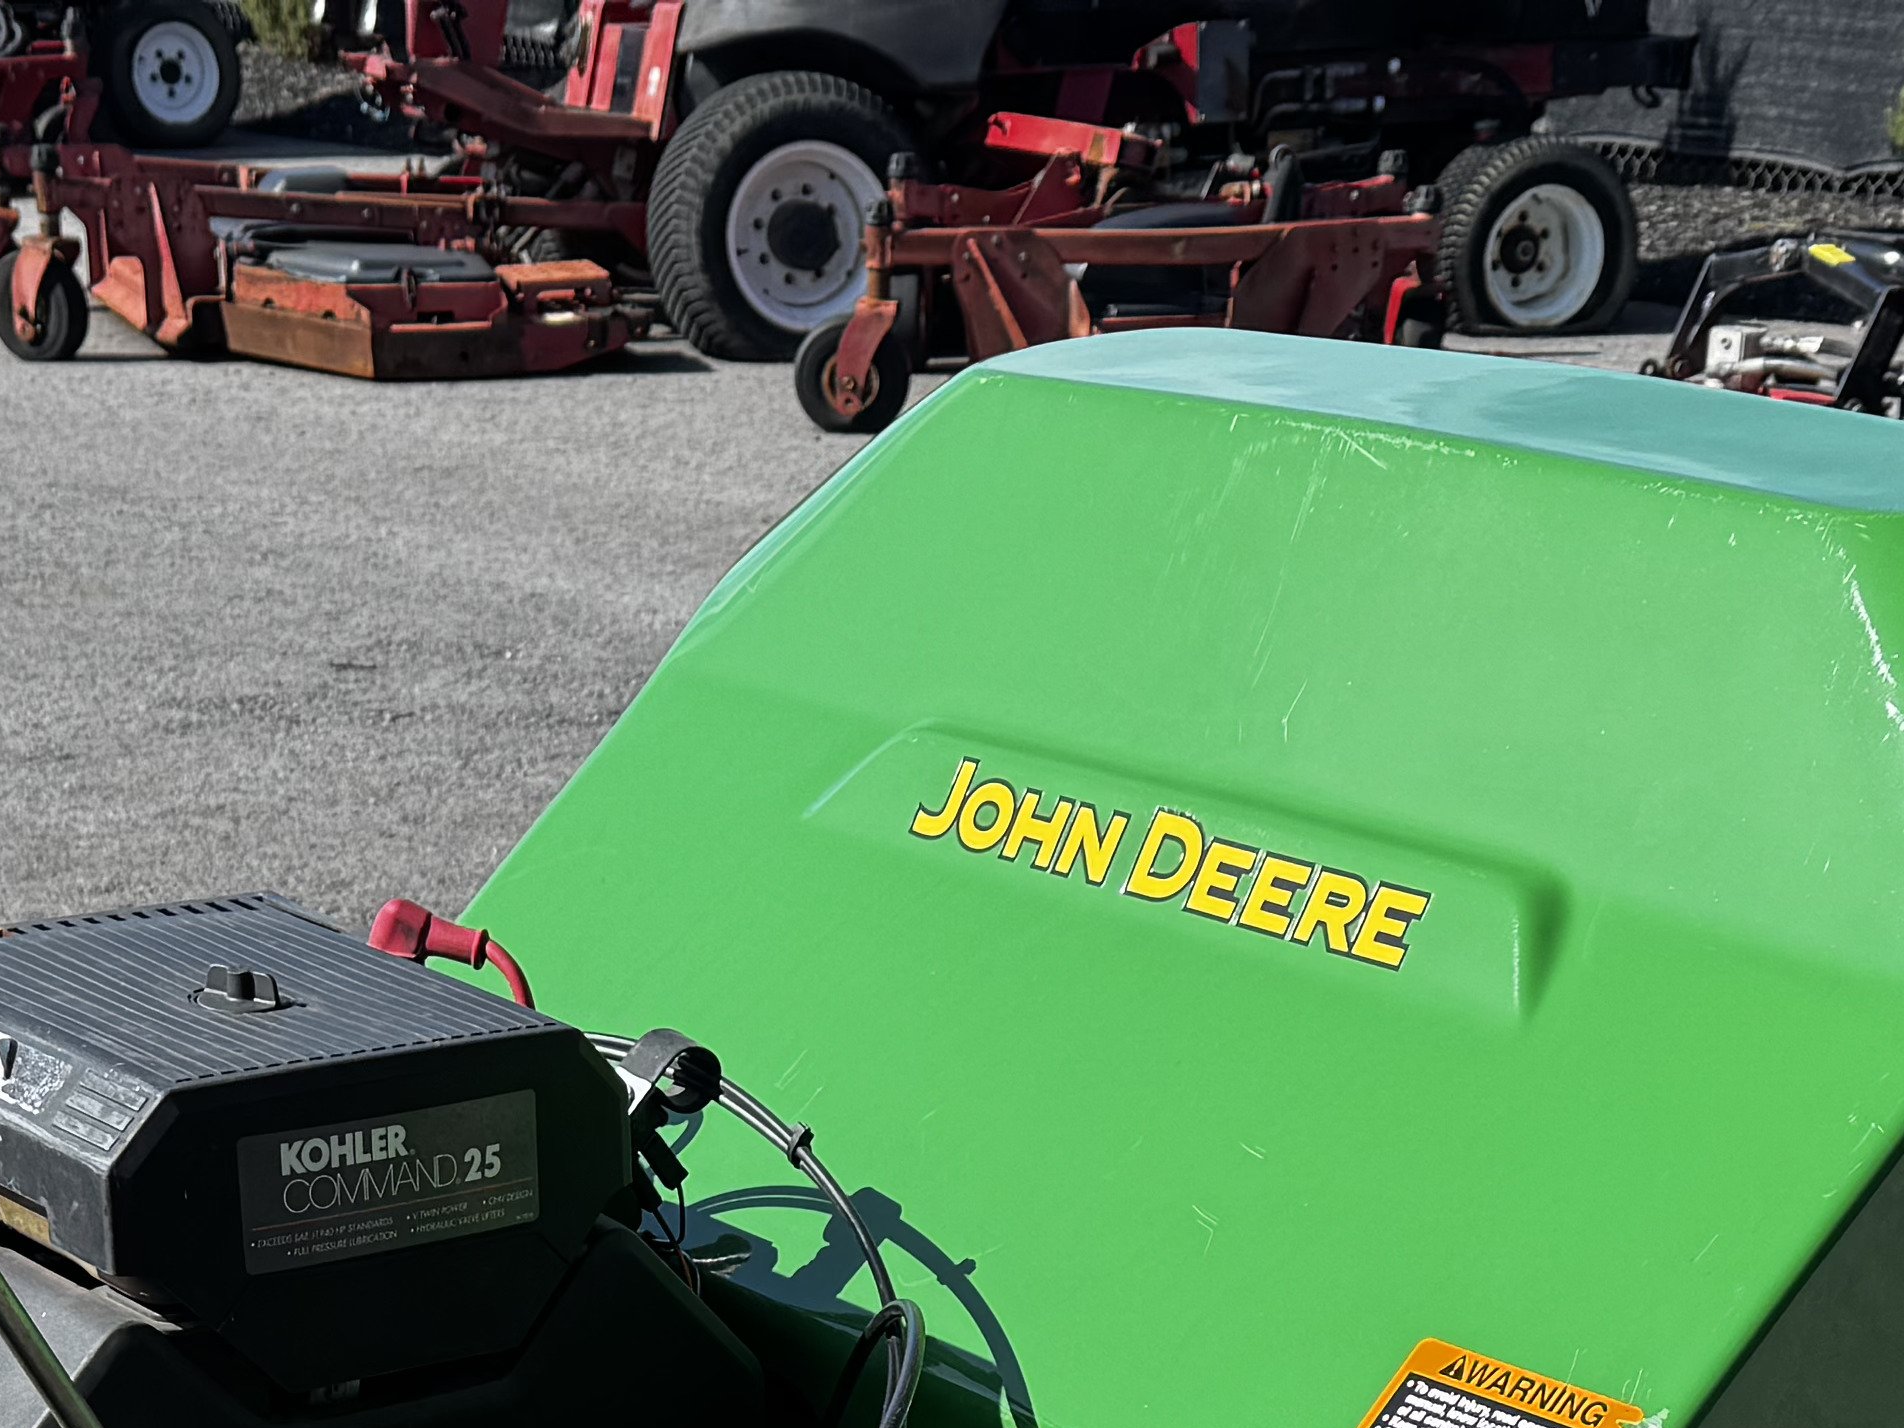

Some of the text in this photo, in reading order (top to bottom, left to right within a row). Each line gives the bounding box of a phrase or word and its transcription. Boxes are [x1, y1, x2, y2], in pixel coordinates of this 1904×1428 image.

[909, 757, 1432, 971] JOHN DEERE
[280, 1125, 406, 1175] KOHLER
[283, 1144, 501, 1213] COMMAND 25
[1396, 1406, 1412, 1417] of
[1408, 1410, 1427, 1422] all
[1405, 1394, 1446, 1417] manual,
[1446, 1407, 1478, 1426] know
[1414, 1381, 1429, 1395] To
[1427, 1388, 1460, 1405] avoid
[1457, 1397, 1491, 1418] injury,
[1491, 1410, 1521, 1426] read
[1467, 1361, 1608, 1427] WARNING
